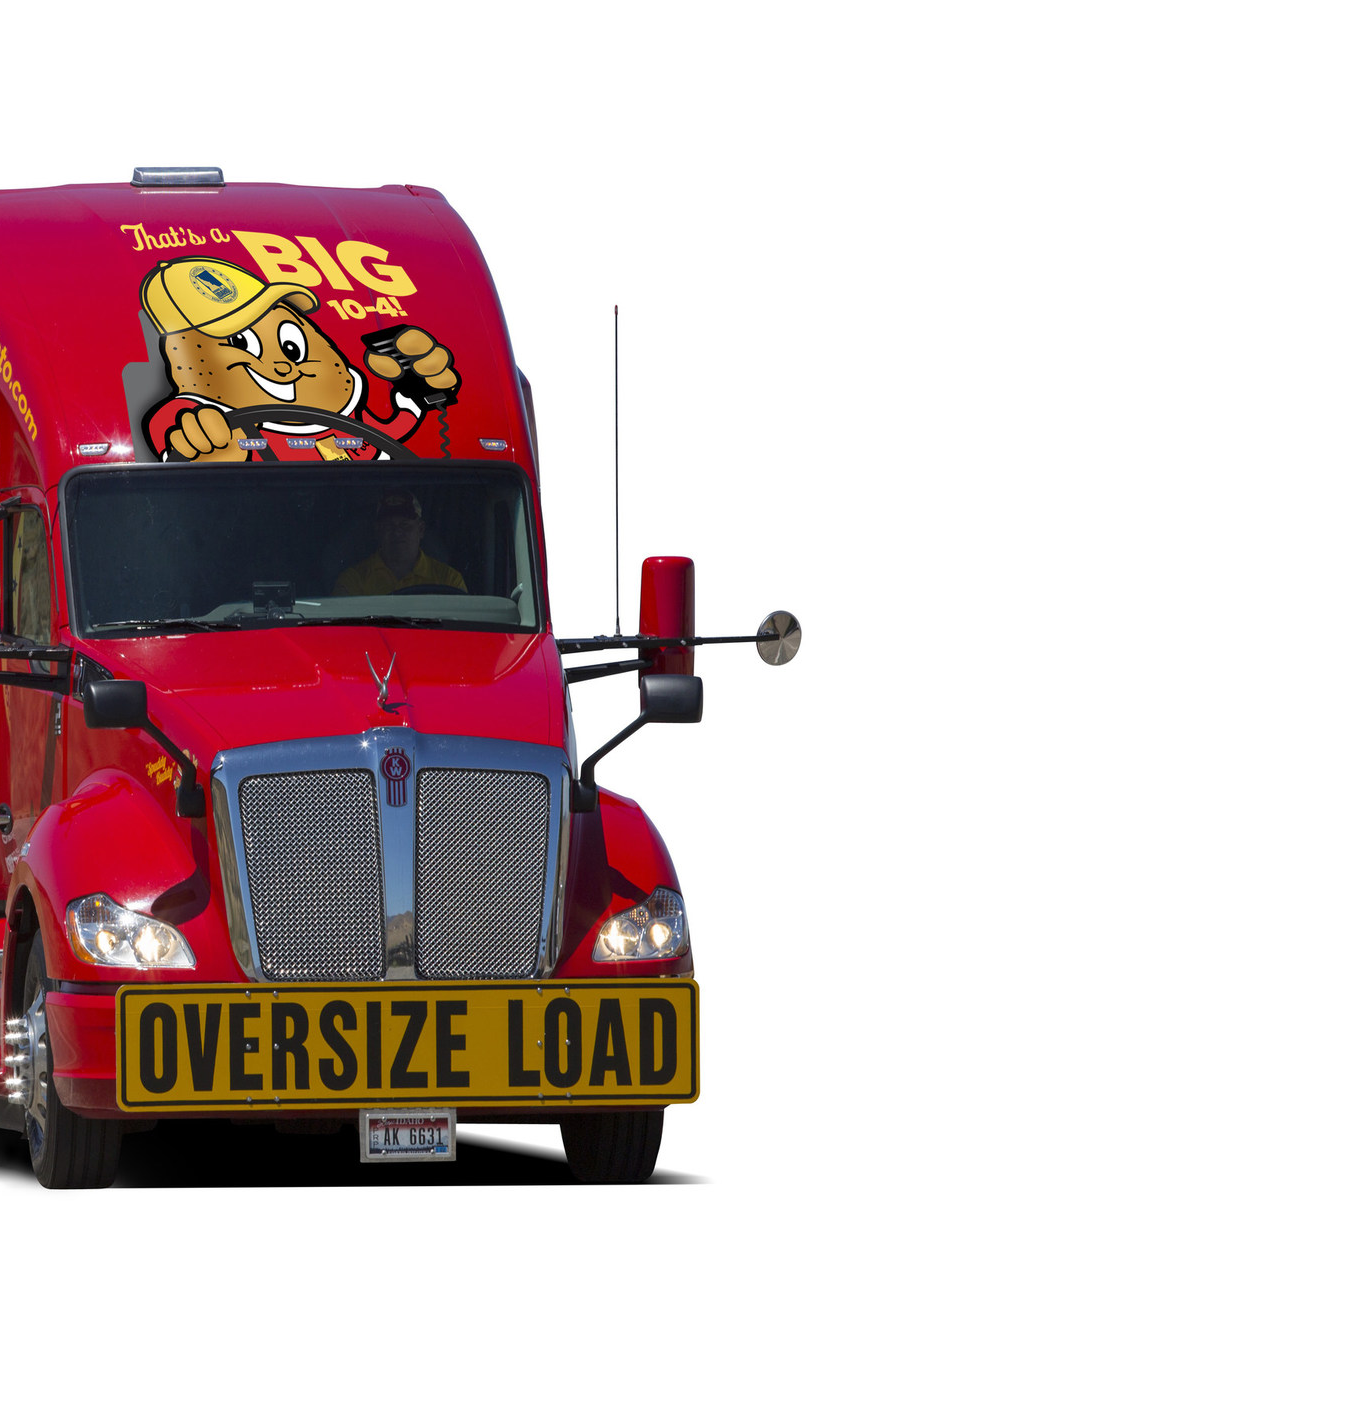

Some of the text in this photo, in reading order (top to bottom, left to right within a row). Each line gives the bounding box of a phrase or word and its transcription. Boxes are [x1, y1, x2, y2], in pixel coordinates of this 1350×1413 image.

[120, 222, 230, 251] That's a
[231, 229, 418, 297] BIG
[327, 296, 408, 320] 10-4!
[139, 998, 677, 1094] OVERSIZE LOAD
[384, 1127, 444, 1146] AK 6631
